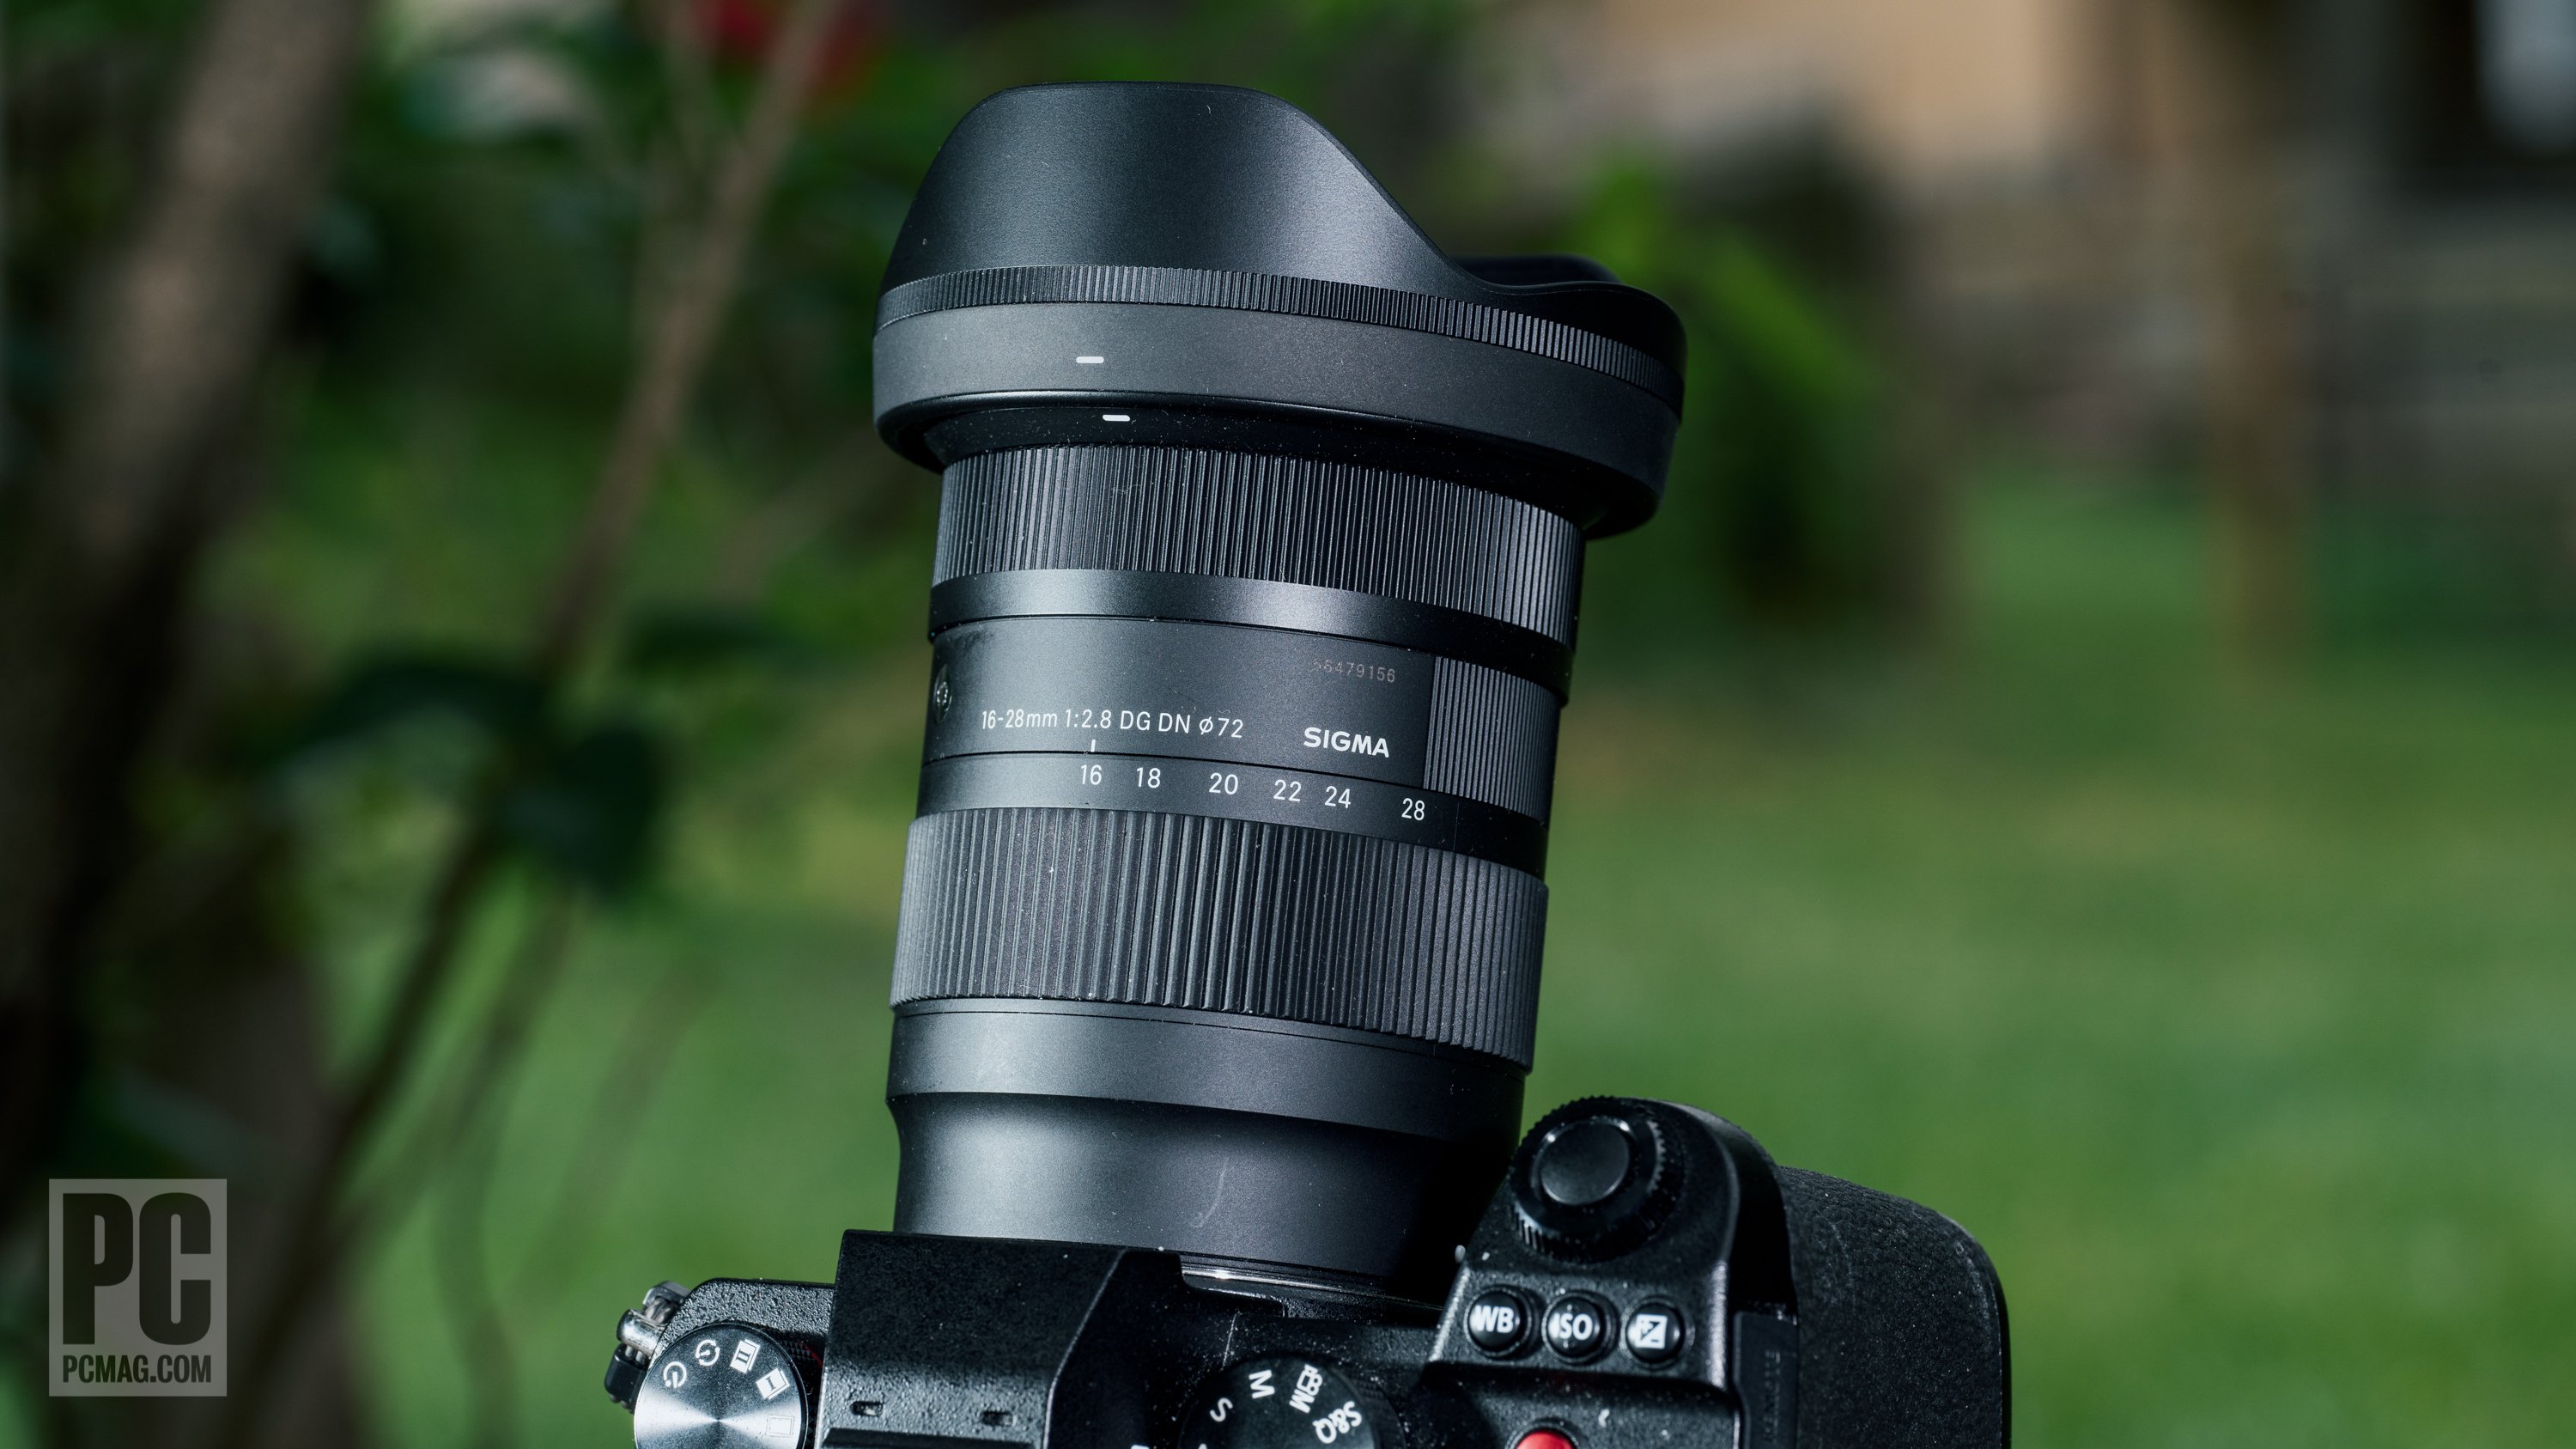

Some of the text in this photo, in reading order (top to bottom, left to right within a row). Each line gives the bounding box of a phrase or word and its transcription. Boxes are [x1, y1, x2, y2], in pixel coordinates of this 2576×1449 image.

[982, 709, 1058, 729] 16-28mm
[1065, 709, 1112, 729] 1:2.8
[1120, 709, 1151, 731] DG
[1157, 712, 1191, 734] DN
[1303, 726, 1389, 758] SIGMA
[1080, 764, 1425, 821] 16 18 20 22 24 28
[1467, 1305, 1515, 1334] WB
[1548, 1312, 1594, 1341] ISO
[1249, 1369, 1275, 1399] M
[1209, 1397, 1233, 1422] S
[1312, 1400, 1363, 1444] S&Q
